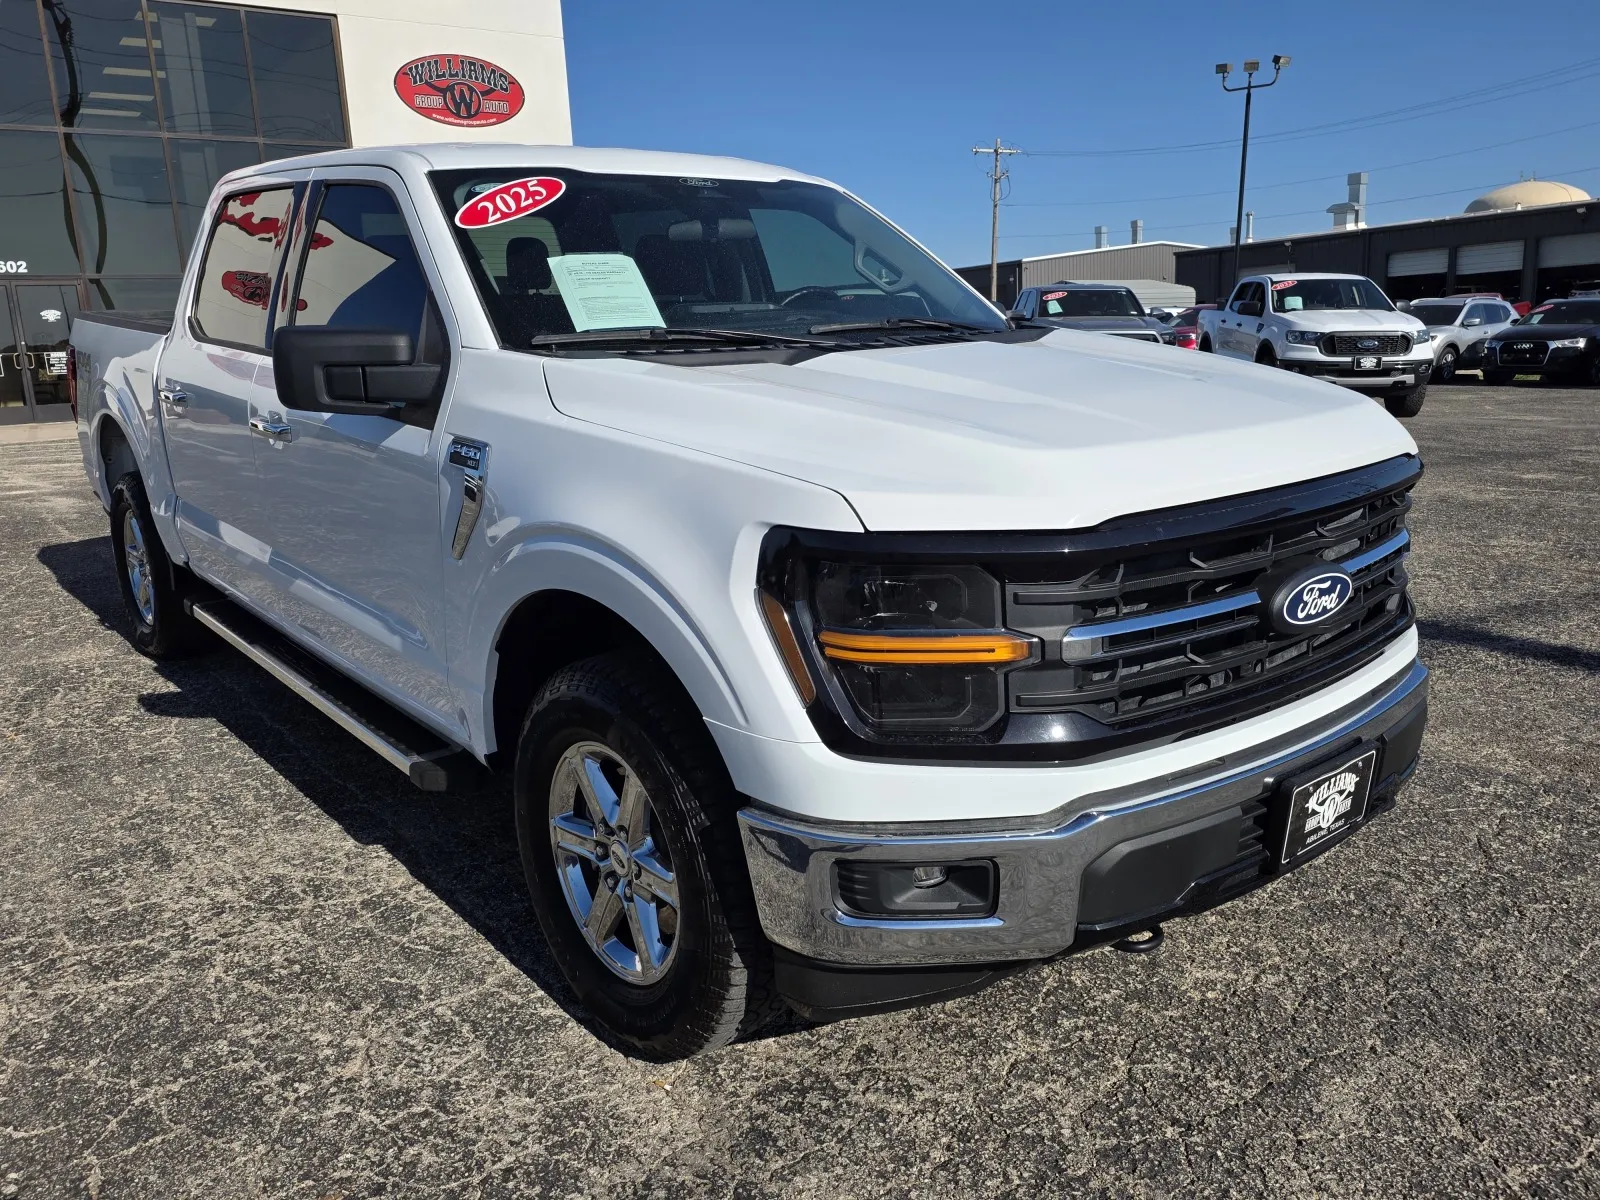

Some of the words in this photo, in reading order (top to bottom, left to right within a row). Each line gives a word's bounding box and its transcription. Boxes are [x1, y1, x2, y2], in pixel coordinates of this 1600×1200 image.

[407, 58, 509, 93] WILLIAMS
[414, 94, 443, 108] GROUP
[483, 100, 509, 113] AUTO
[477, 180, 547, 223] 2025
[1297, 580, 1341, 619] Ford
[1307, 772, 1357, 814] WILLIAMS
